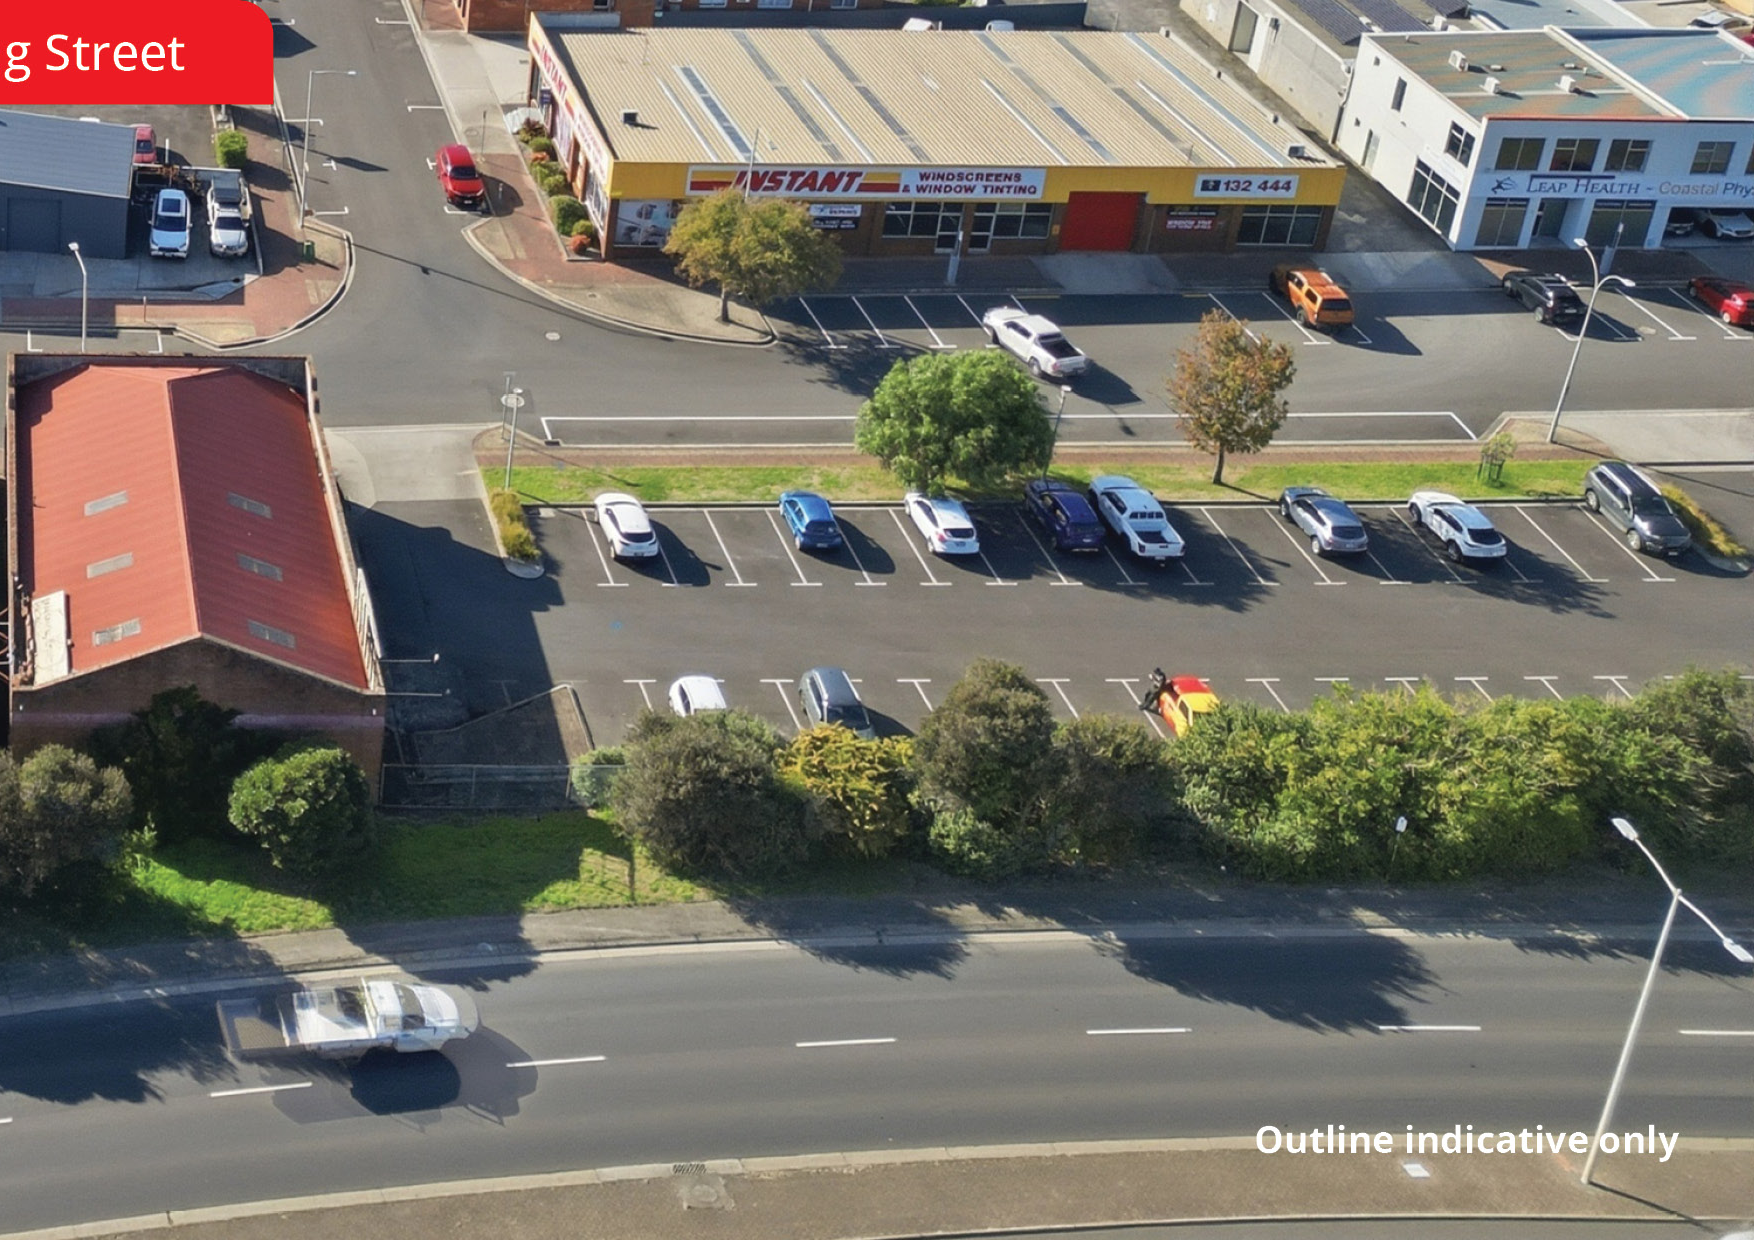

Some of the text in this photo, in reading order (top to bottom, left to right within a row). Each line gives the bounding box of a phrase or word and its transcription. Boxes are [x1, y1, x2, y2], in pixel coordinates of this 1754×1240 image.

[733, 170, 863, 193] INSTANT
[918, 171, 1023, 183] WINDSCREENS
[915, 183, 976, 194] WINDOW
[982, 184, 1038, 195] TINTING
[1223, 180, 1292, 192] 132 444
[1526, 176, 1568, 194] LEAP
[1574, 178, 1640, 195] HEALTH
[1659, 181, 1719, 196] Coastal
